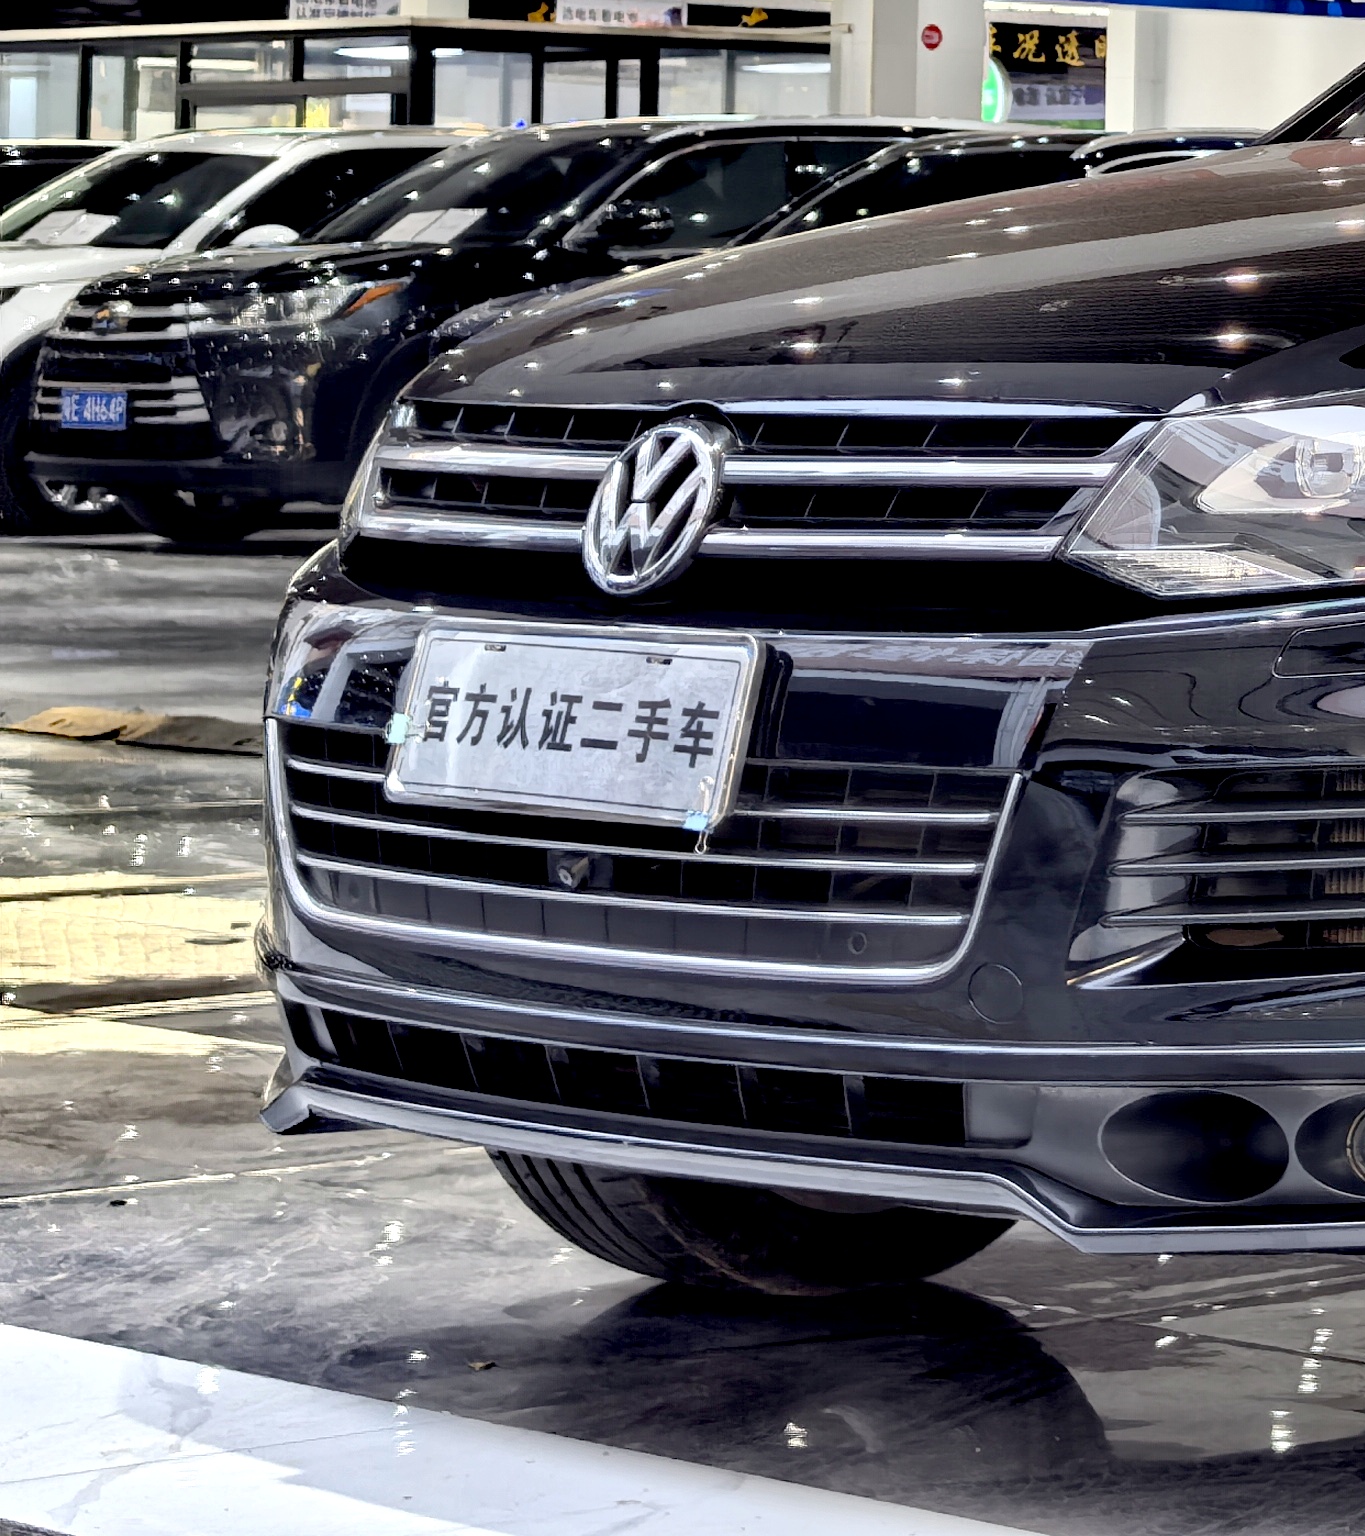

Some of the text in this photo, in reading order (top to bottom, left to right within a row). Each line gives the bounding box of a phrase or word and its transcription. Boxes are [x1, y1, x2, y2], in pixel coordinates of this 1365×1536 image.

[423, 678, 721, 768] 官方认证二手车
